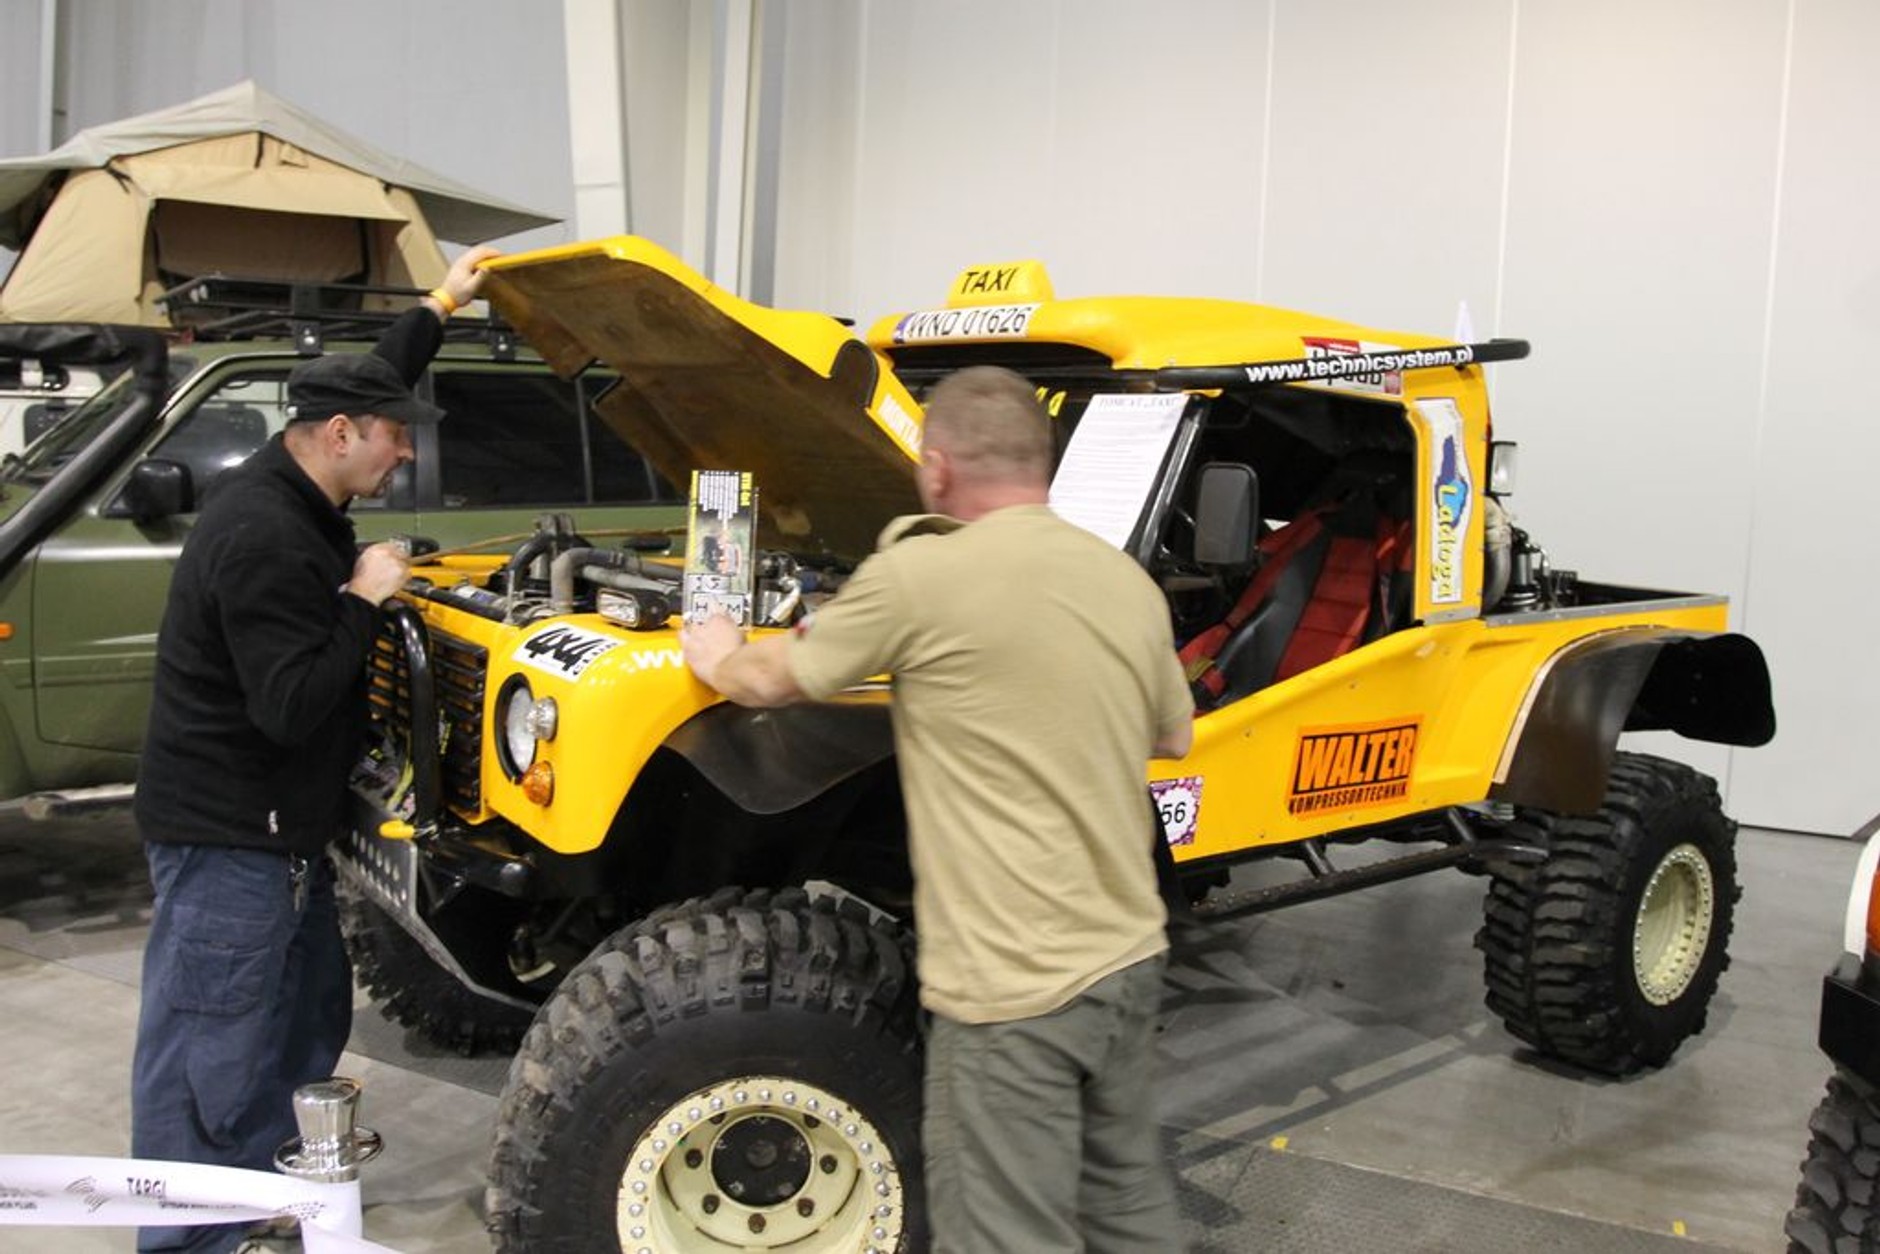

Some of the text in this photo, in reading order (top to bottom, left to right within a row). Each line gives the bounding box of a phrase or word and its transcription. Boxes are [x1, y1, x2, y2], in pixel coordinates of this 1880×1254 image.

[961, 267, 1019, 294] TAXI
[963, 306, 1031, 335] 01626
[1298, 728, 1415, 791] WALTER
